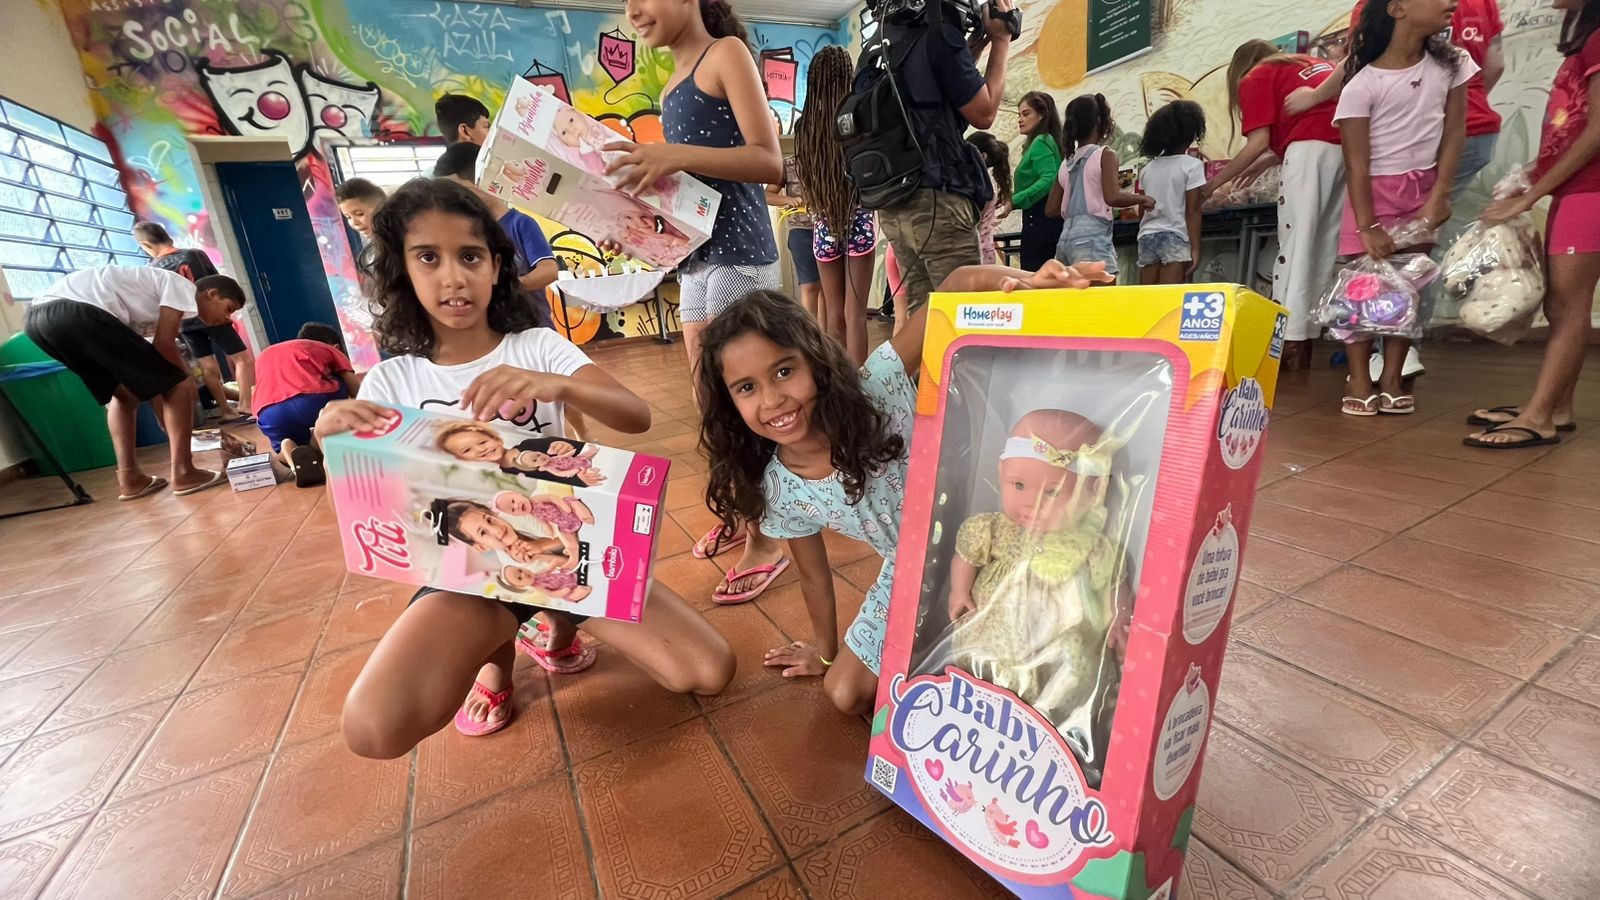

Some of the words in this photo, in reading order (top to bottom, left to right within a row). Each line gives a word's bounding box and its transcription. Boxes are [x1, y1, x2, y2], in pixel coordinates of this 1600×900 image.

[443, 30, 515, 62] AZUL
[1182, 318, 1220, 329] ANOS
[1238, 377, 1259, 401] Baby
[606, 548, 618, 578] bambola
[950, 676, 1050, 760] Baby
[891, 675, 1114, 844] Carinho
